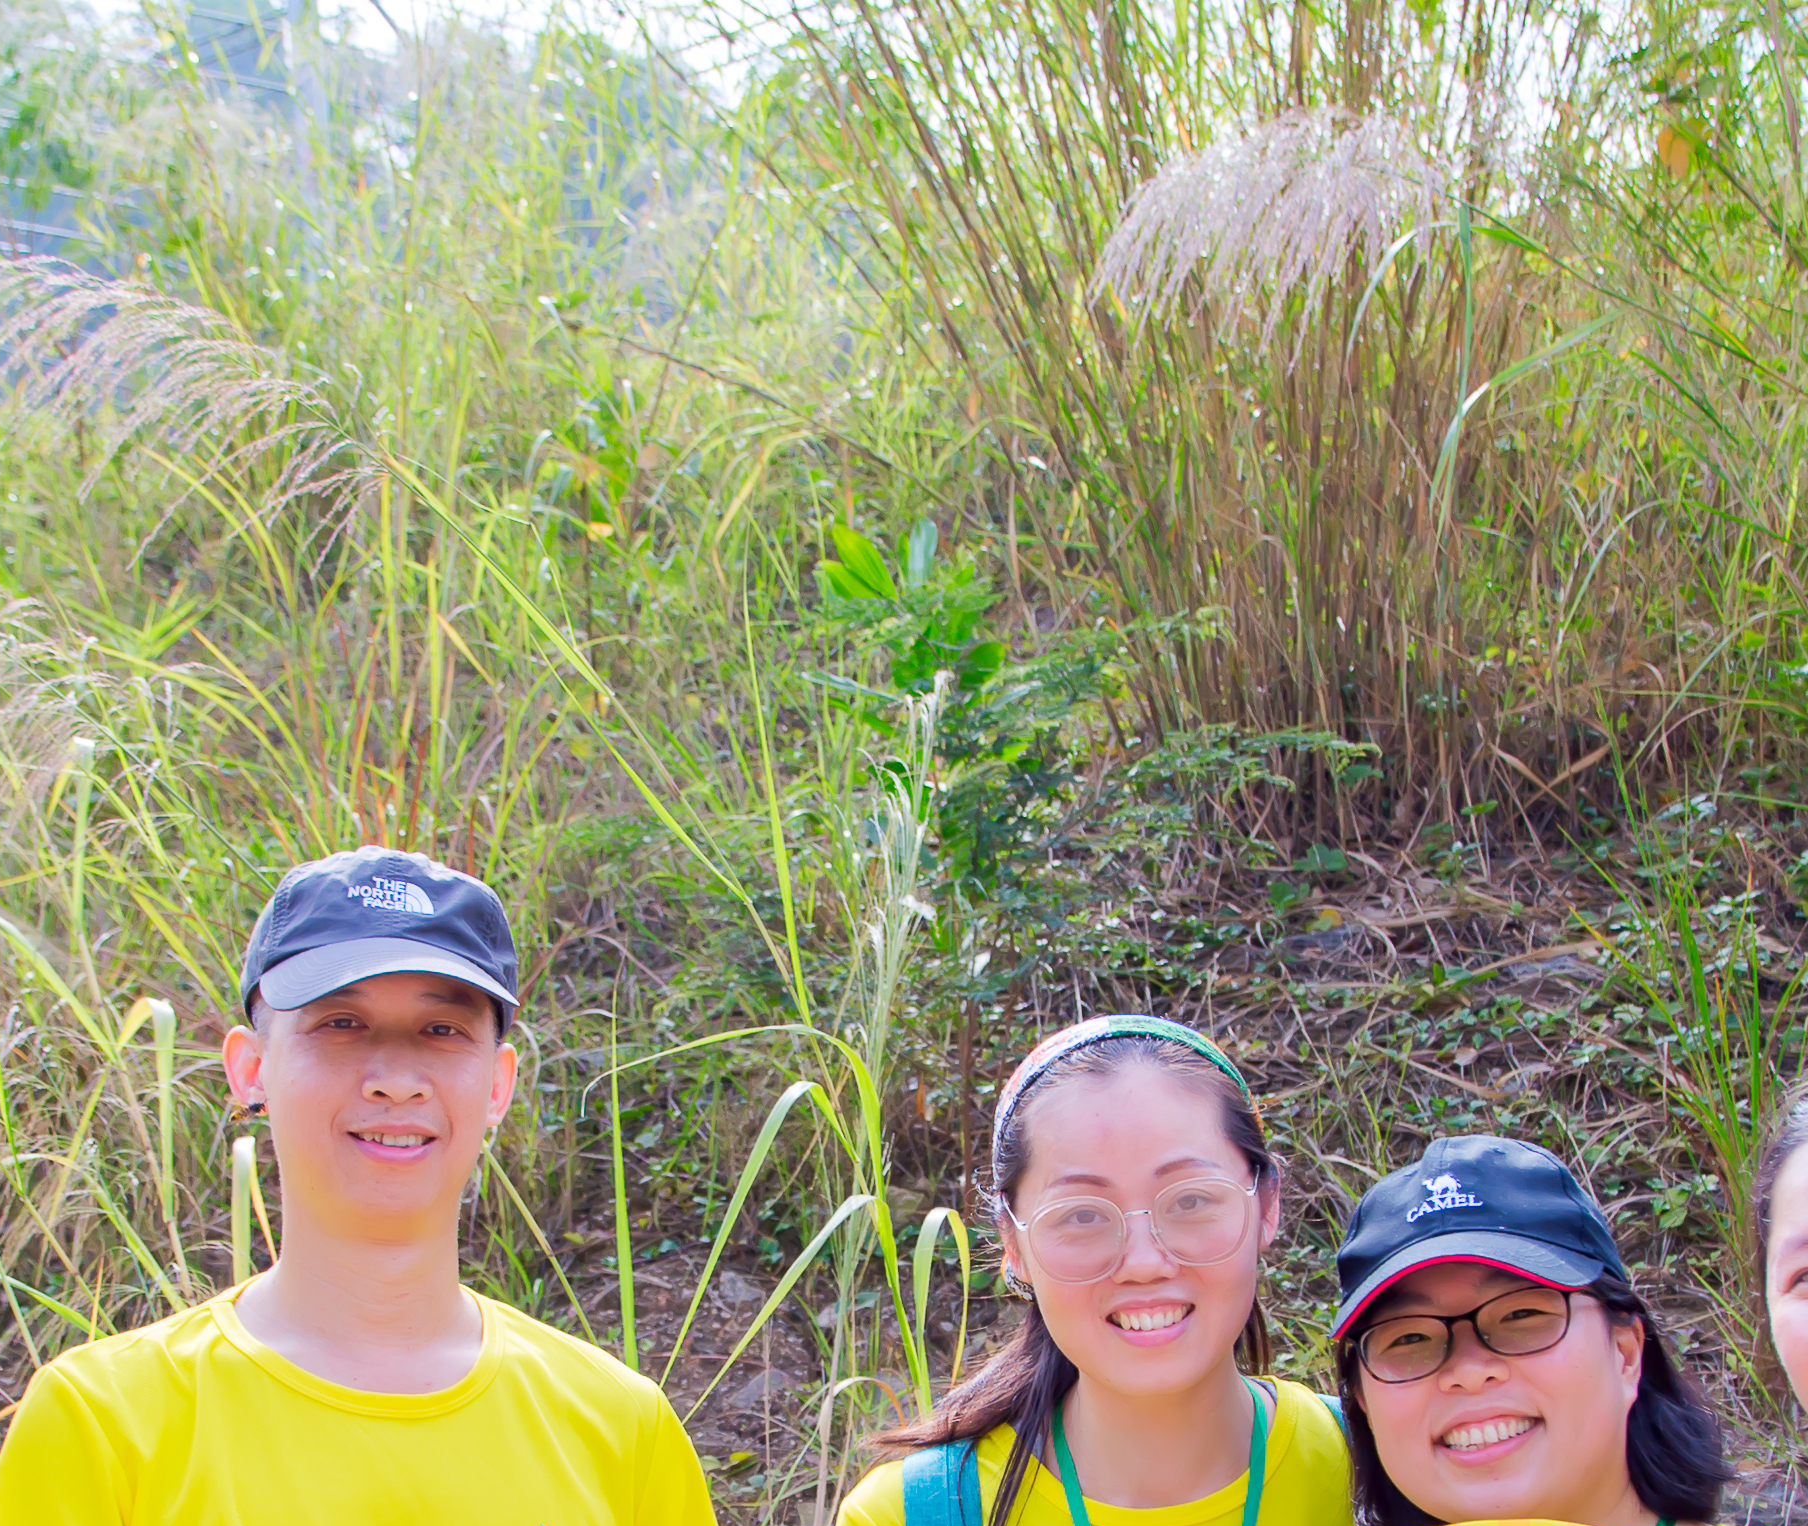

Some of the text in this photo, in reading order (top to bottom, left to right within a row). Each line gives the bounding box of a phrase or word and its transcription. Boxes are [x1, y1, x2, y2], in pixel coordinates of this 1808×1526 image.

[372, 876, 406, 893] THE
[347, 885, 406, 901] NORTH
[362, 897, 406, 912] FACE
[1406, 1193, 1483, 1223] CAMEL
